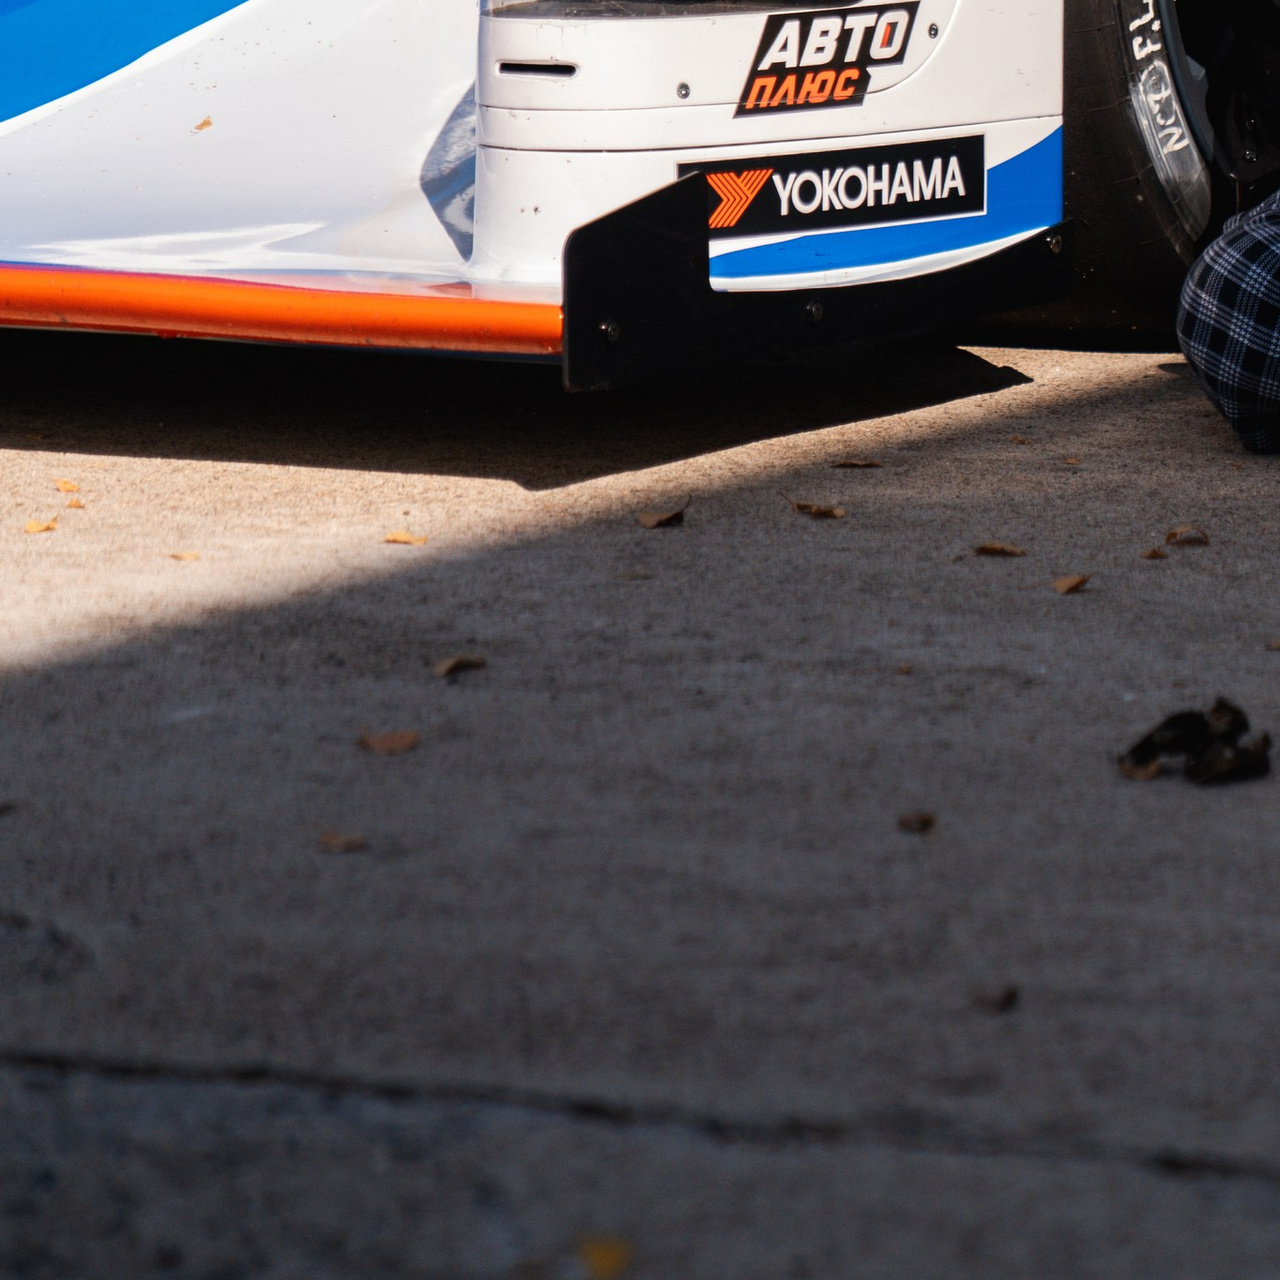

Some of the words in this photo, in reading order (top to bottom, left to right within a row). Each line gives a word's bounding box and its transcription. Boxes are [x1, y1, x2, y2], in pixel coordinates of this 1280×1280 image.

[757, 8, 910, 72] АВТО
[745, 67, 861, 110] ПЛЮС
[772, 156, 966, 217] YOKOHAMA
